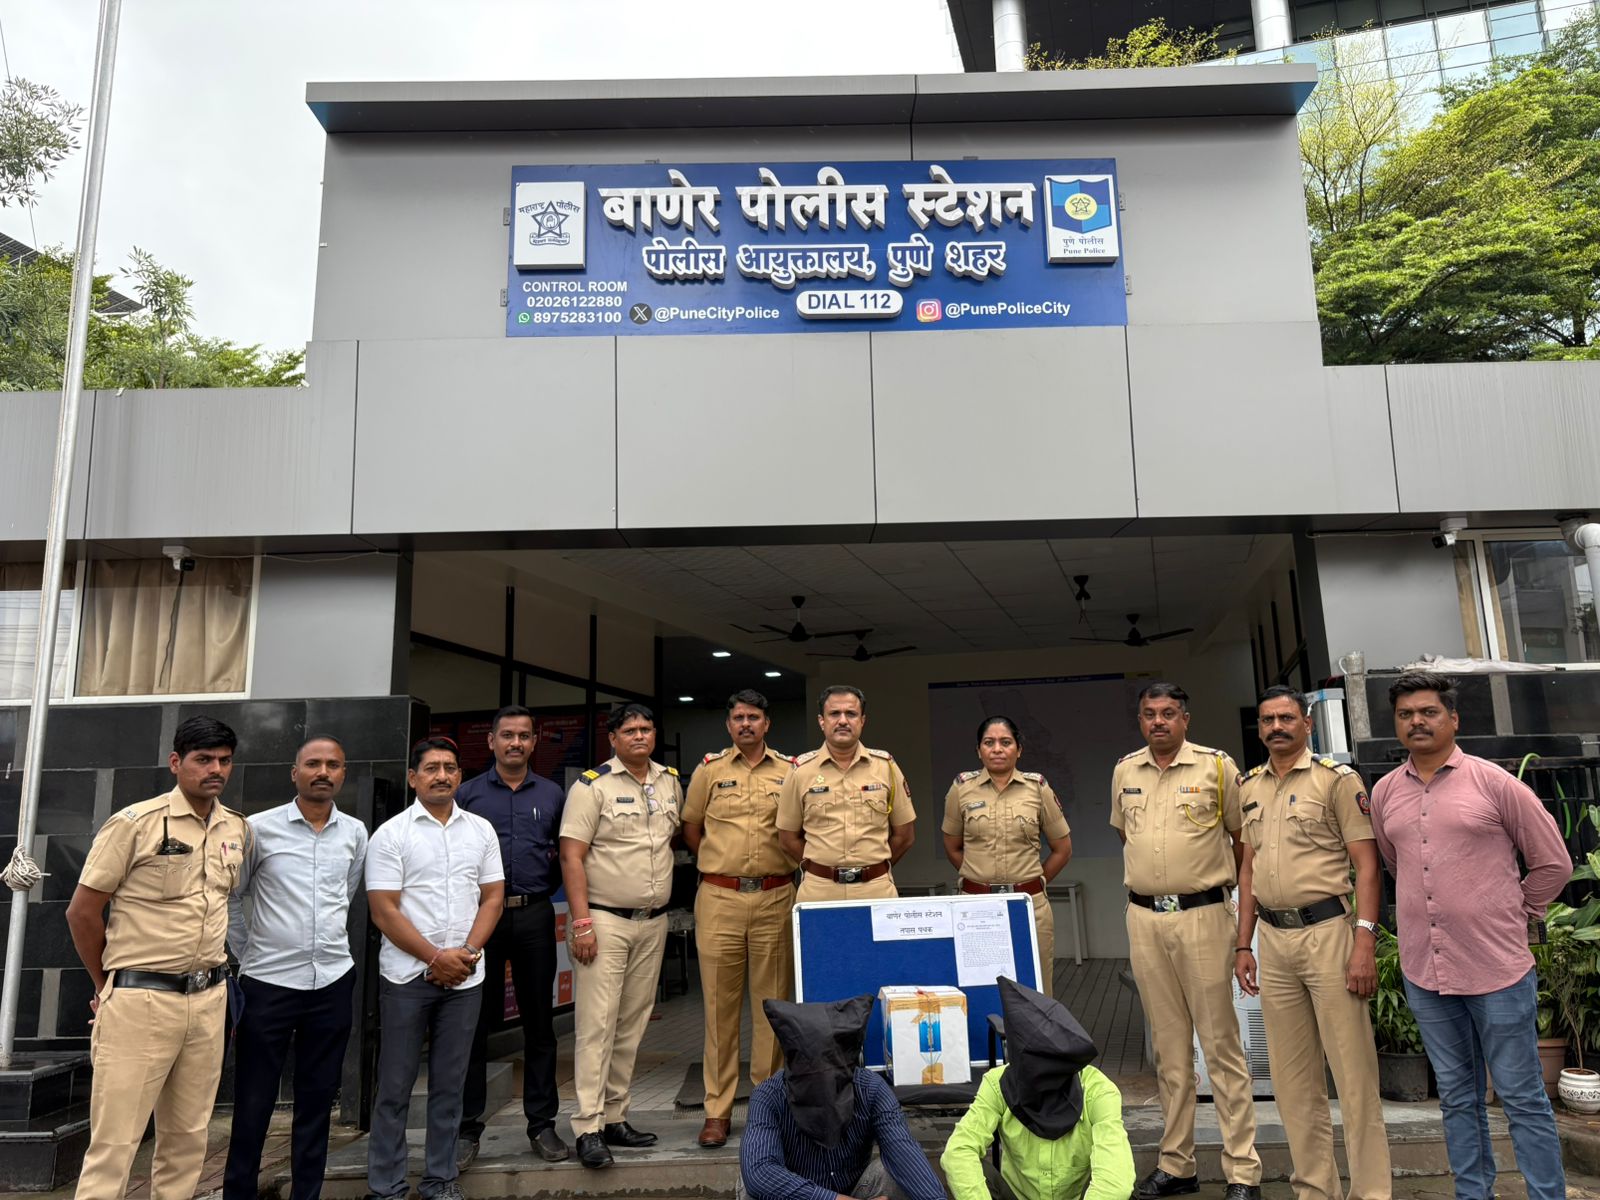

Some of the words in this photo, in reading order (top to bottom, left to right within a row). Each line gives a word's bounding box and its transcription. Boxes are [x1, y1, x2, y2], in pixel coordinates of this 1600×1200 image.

[556, 199, 581, 213] पोलीस
[598, 168, 721, 233] बाणेर
[735, 166, 889, 231] पोलीस
[902, 164, 1036, 232] स्टेशन
[1062, 236, 1075, 248] पुणे
[1078, 235, 1104, 246] पोलीस
[643, 237, 727, 280] पोलीस
[888, 233, 934, 288] पुणे
[944, 241, 1007, 281] शहर
[522, 281, 586, 293] CONTROL
[588, 281, 628, 292] ROOM
[527, 296, 623, 308] 02026122880
[807, 294, 855, 310] DIAL
[859, 293, 892, 309] 112
[654, 306, 780, 322] @PuneCityPolice
[945, 301, 1071, 318] @PunePoliceCity
[533, 311, 622, 324] 8975283100
